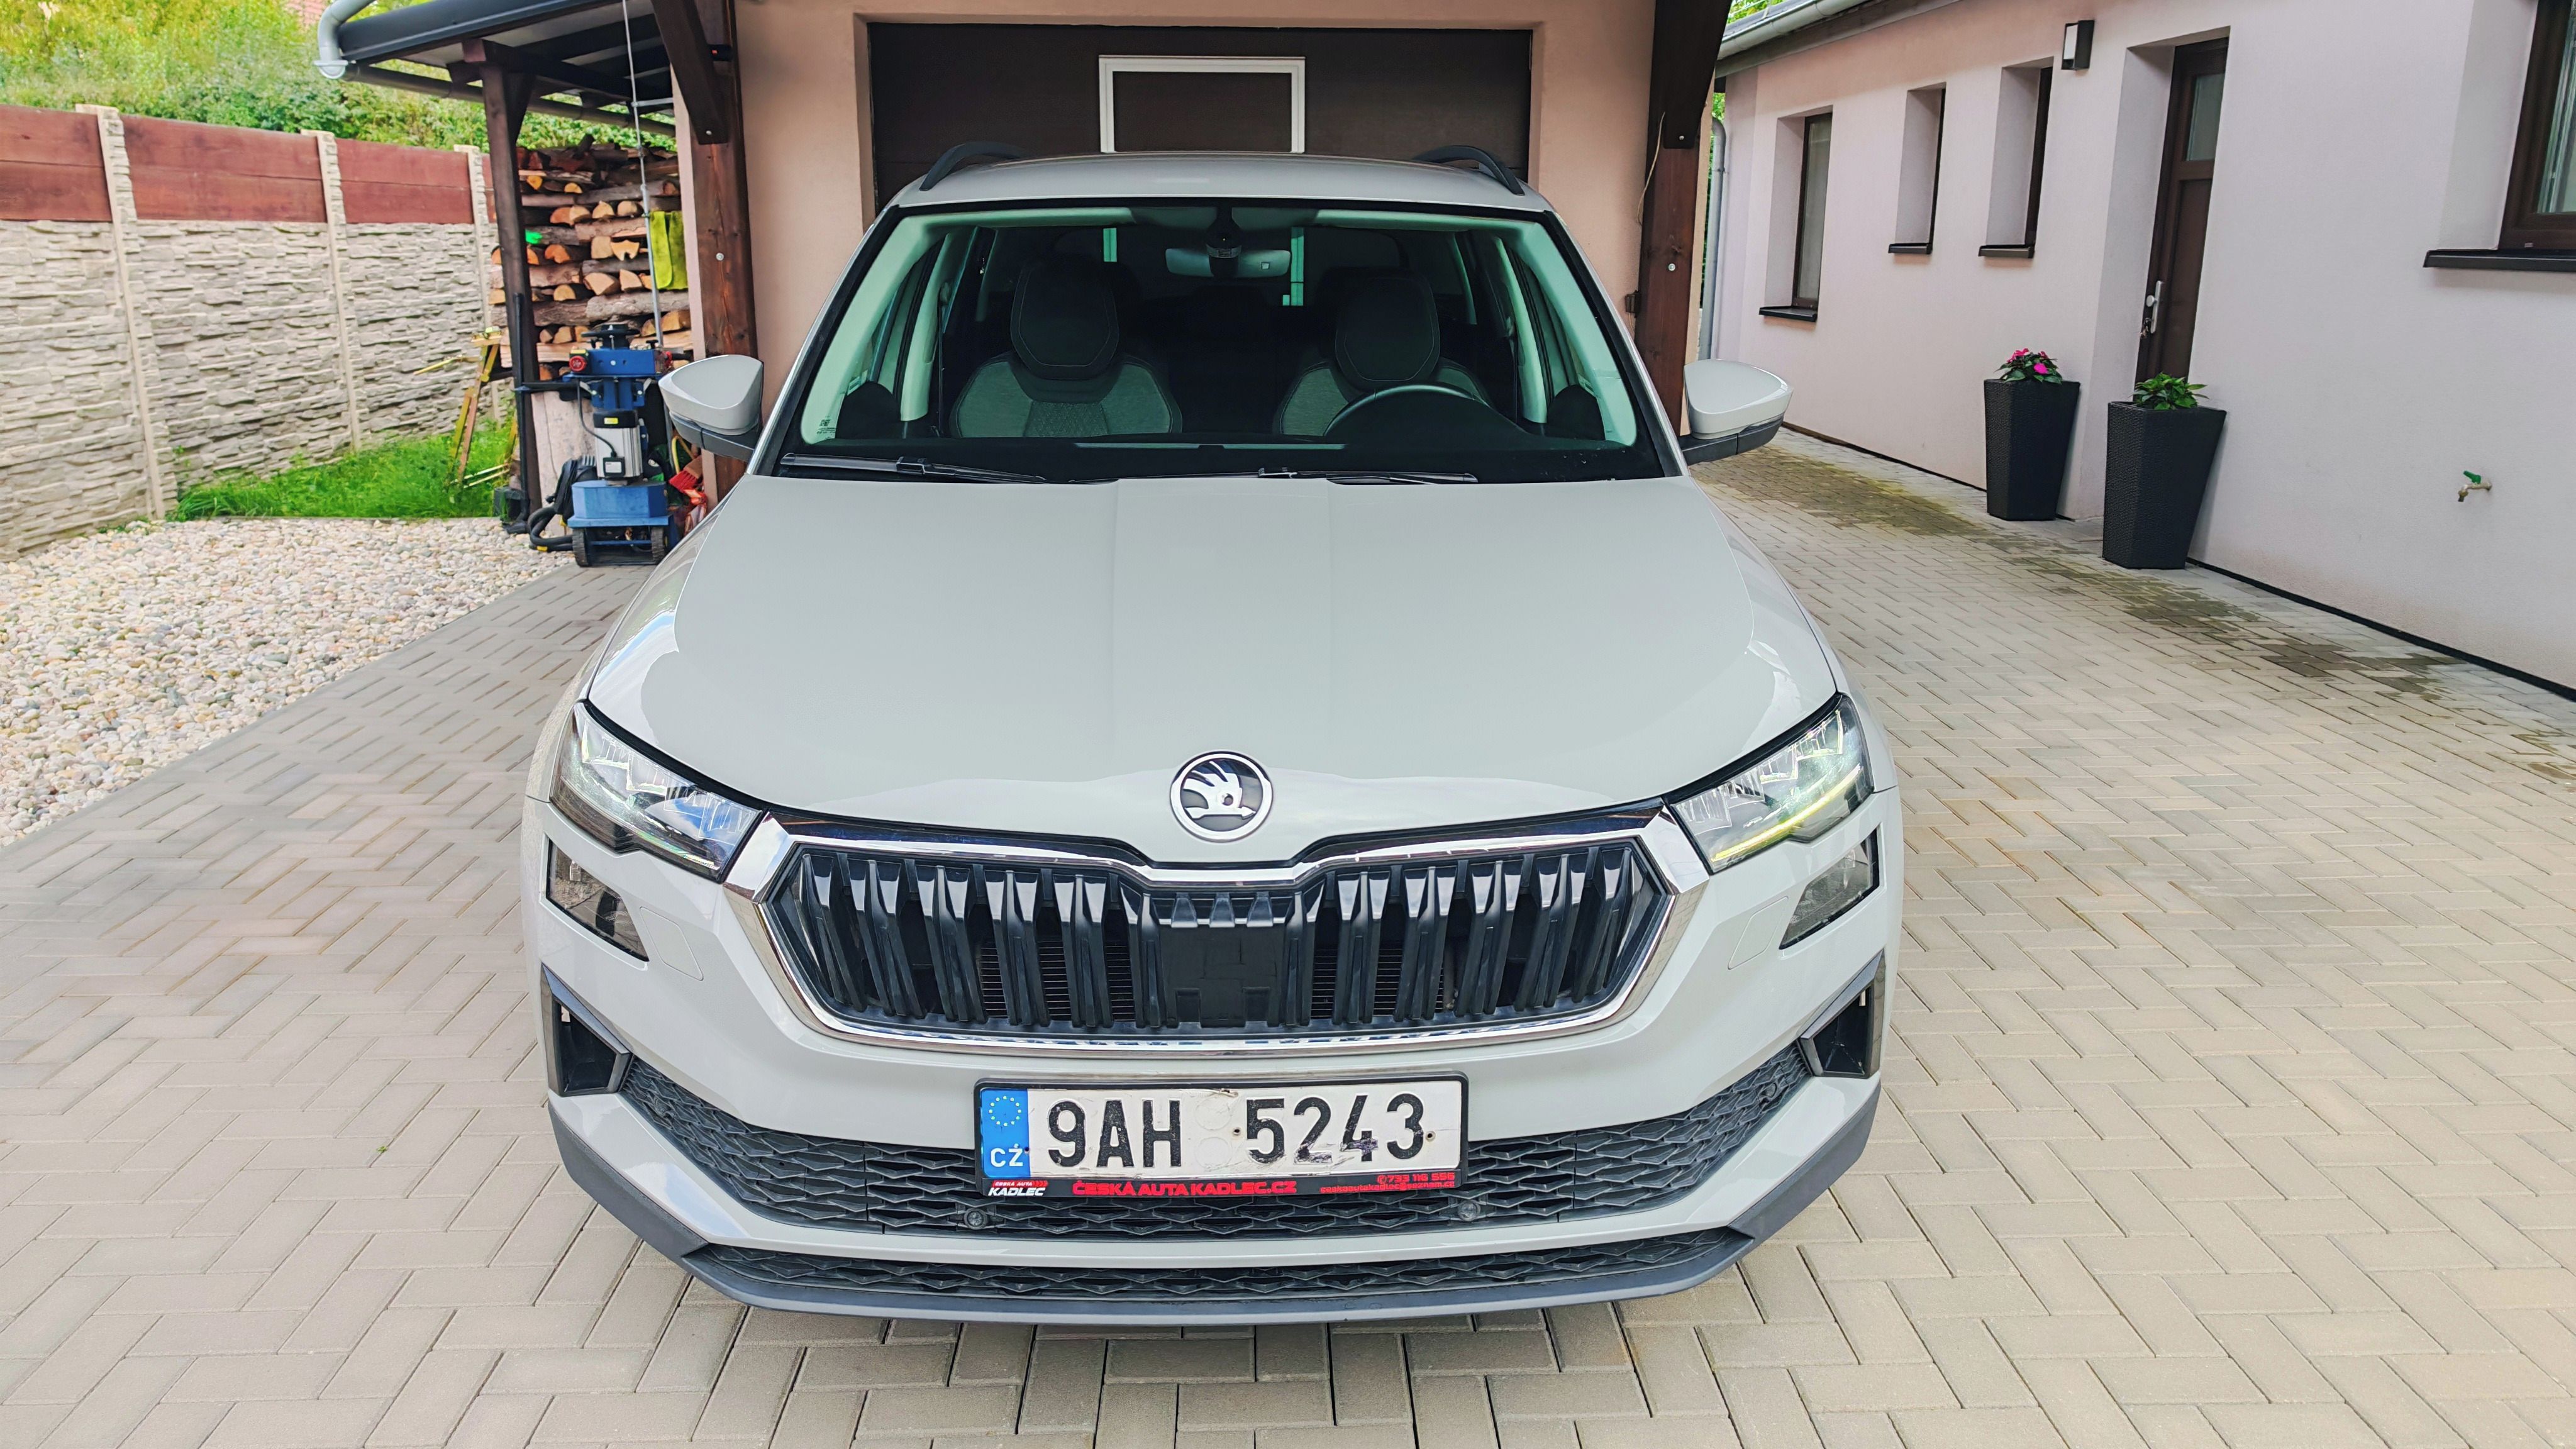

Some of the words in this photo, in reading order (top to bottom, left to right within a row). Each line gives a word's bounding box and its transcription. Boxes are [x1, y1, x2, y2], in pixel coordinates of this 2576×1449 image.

[1048, 1100, 1181, 1167] 9AH
[1246, 1093, 1424, 1164] 5243
[990, 1148, 1023, 1167] CZ
[988, 1187, 1046, 1196] KADLEC
[1072, 1180, 1136, 1196] ČESKÁ
[1139, 1183, 1189, 1196] AUTA
[1191, 1180, 1297, 1196] KADLEC.CZ
